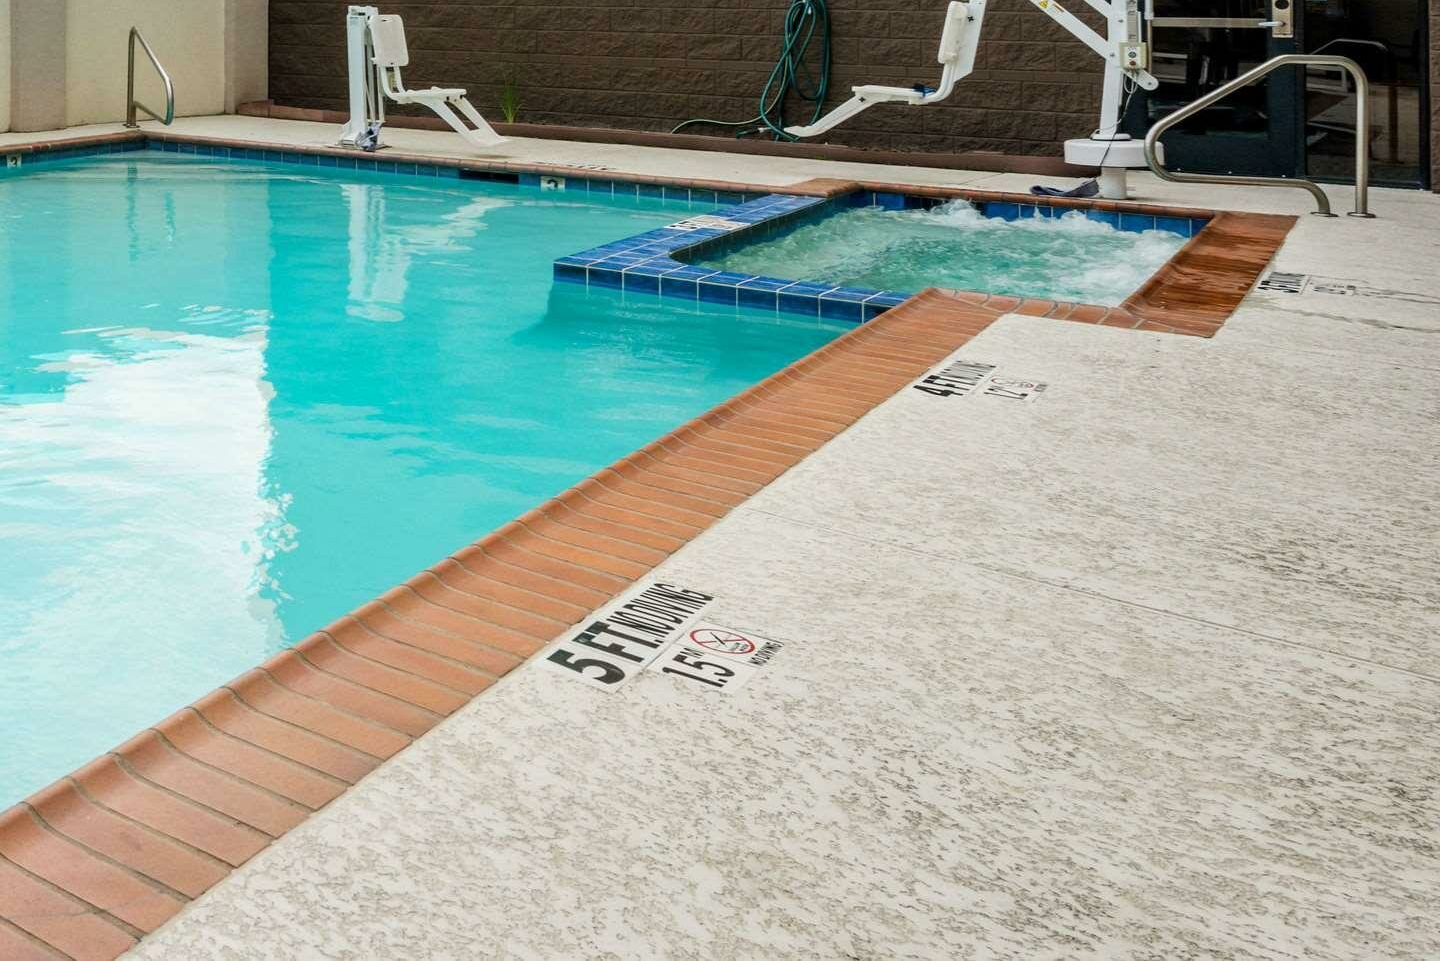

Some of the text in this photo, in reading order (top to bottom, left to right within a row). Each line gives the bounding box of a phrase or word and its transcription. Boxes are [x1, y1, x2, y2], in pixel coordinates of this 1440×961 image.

[913, 385, 964, 397] 4
[622, 583, 713, 625] DIVING
[606, 610, 677, 638] NO
[546, 649, 626, 685] 5
